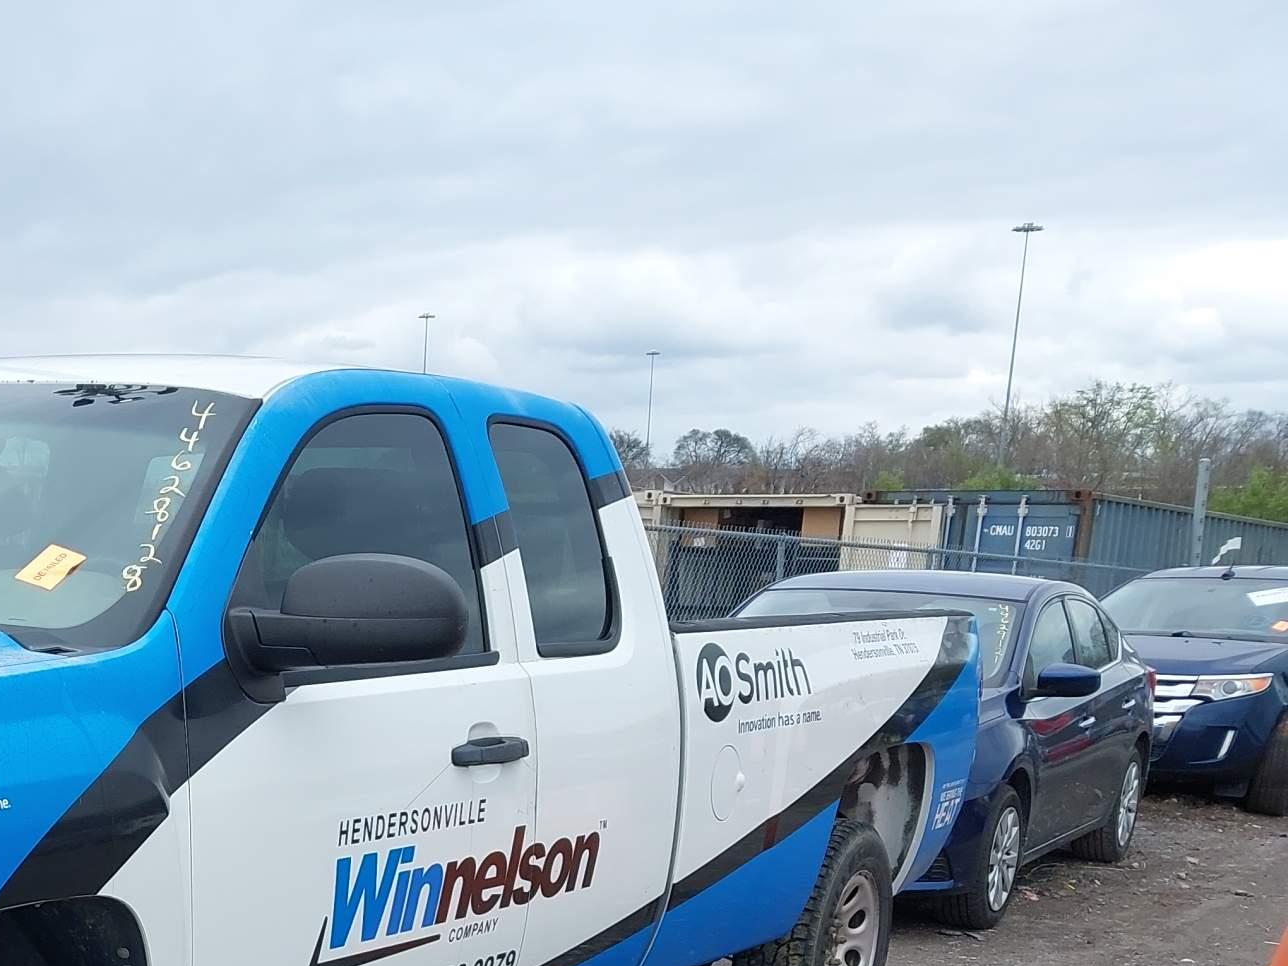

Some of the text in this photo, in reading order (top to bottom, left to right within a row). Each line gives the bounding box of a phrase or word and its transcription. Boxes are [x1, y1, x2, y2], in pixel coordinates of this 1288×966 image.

[122, 400, 216, 592] 44628128
[1025, 526, 1059, 537] 803073
[1024, 539, 1046, 551] 42G1
[861, 629, 886, 643] Industrial
[886, 628, 899, 641] Park
[735, 647, 811, 704] Smith
[738, 714, 775, 734] Innovation
[778, 712, 794, 727] has
[796, 713, 801, 725] a
[337, 799, 486, 847] HENDERSONVILLE
[329, 824, 600, 950] Winnelson
[448, 917, 499, 943] COMPANY
